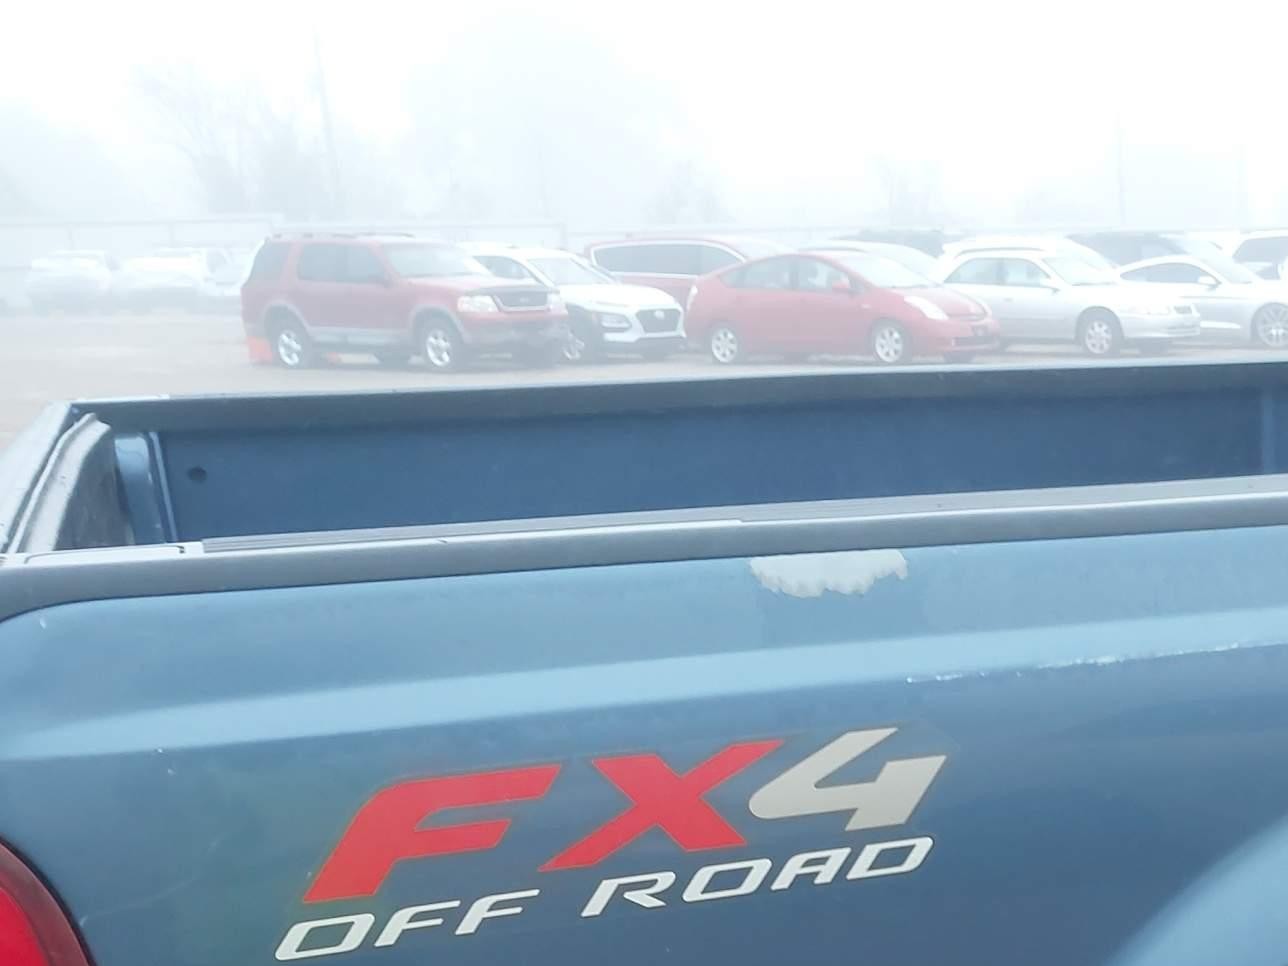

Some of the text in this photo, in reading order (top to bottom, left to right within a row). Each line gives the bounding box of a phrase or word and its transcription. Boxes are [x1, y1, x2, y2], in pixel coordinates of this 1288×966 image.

[302, 727, 947, 904] FX4
[274, 835, 934, 962] OFF ROAD
